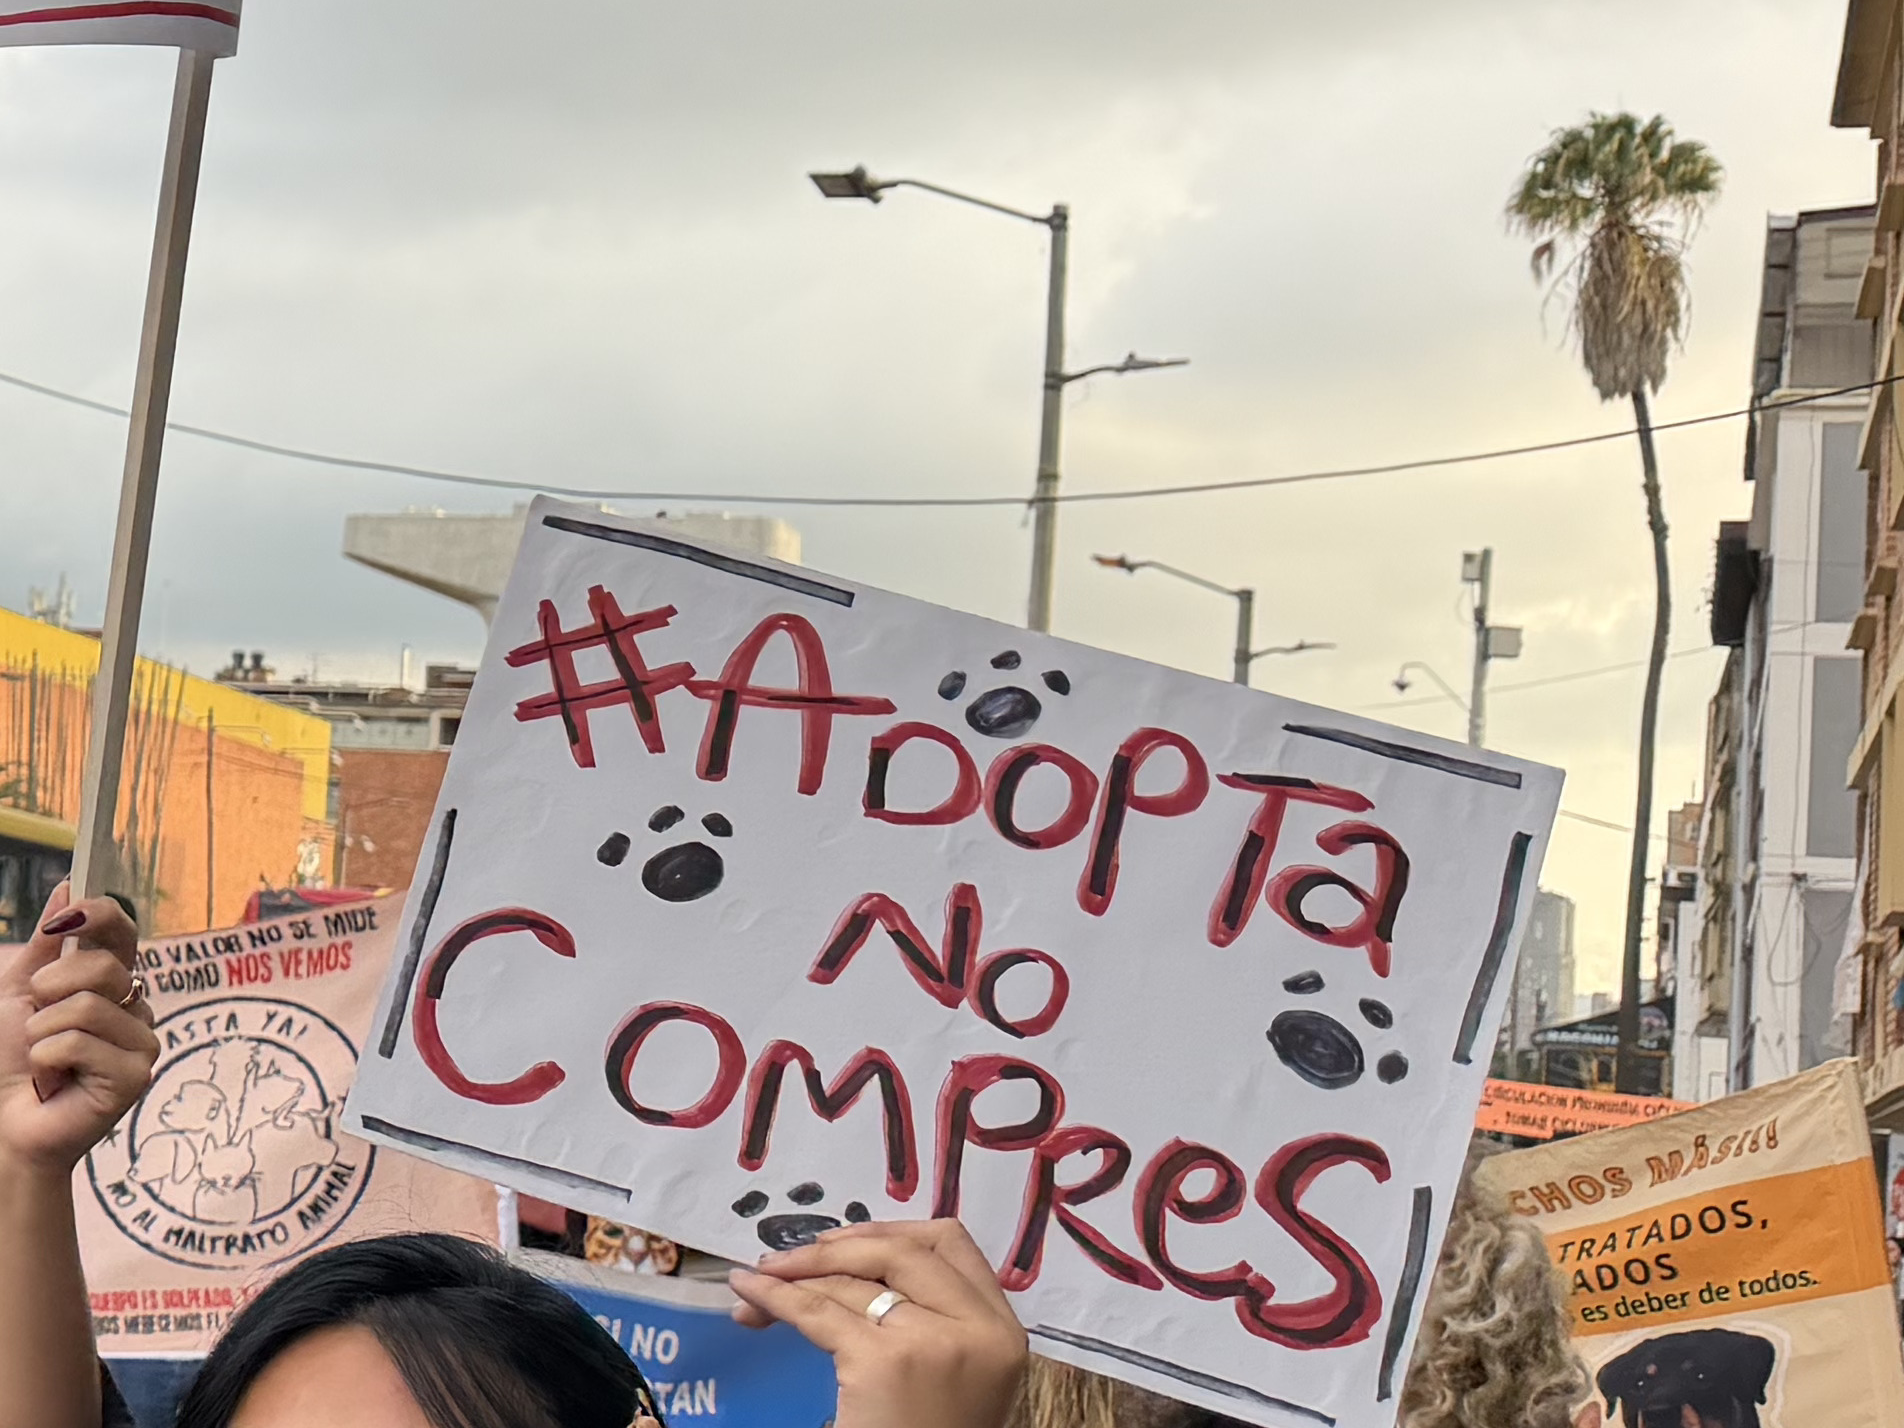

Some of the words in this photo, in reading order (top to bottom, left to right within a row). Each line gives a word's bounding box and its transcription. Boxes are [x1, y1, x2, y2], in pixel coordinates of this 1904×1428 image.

[166, 934, 242, 965] VALOR
[246, 925, 283, 950] NO
[288, 918, 315, 941] SE
[322, 905, 380, 940] MIDE
[225, 950, 275, 989] NOS
[278, 939, 354, 981] VEMOS
[106, 1178, 137, 1209] NO
[132, 1207, 160, 1234] AL
[162, 1220, 290, 1256] MALTRATO
[295, 1160, 357, 1231] ANIMAL
[1580, 1303, 1610, 1323] es
[1614, 1289, 1691, 1319] deber
[1698, 1280, 1731, 1305] de
[1738, 1268, 1823, 1298] todos.
[630, 1323, 680, 1365] NO
[644, 1376, 717, 1416] TAN
